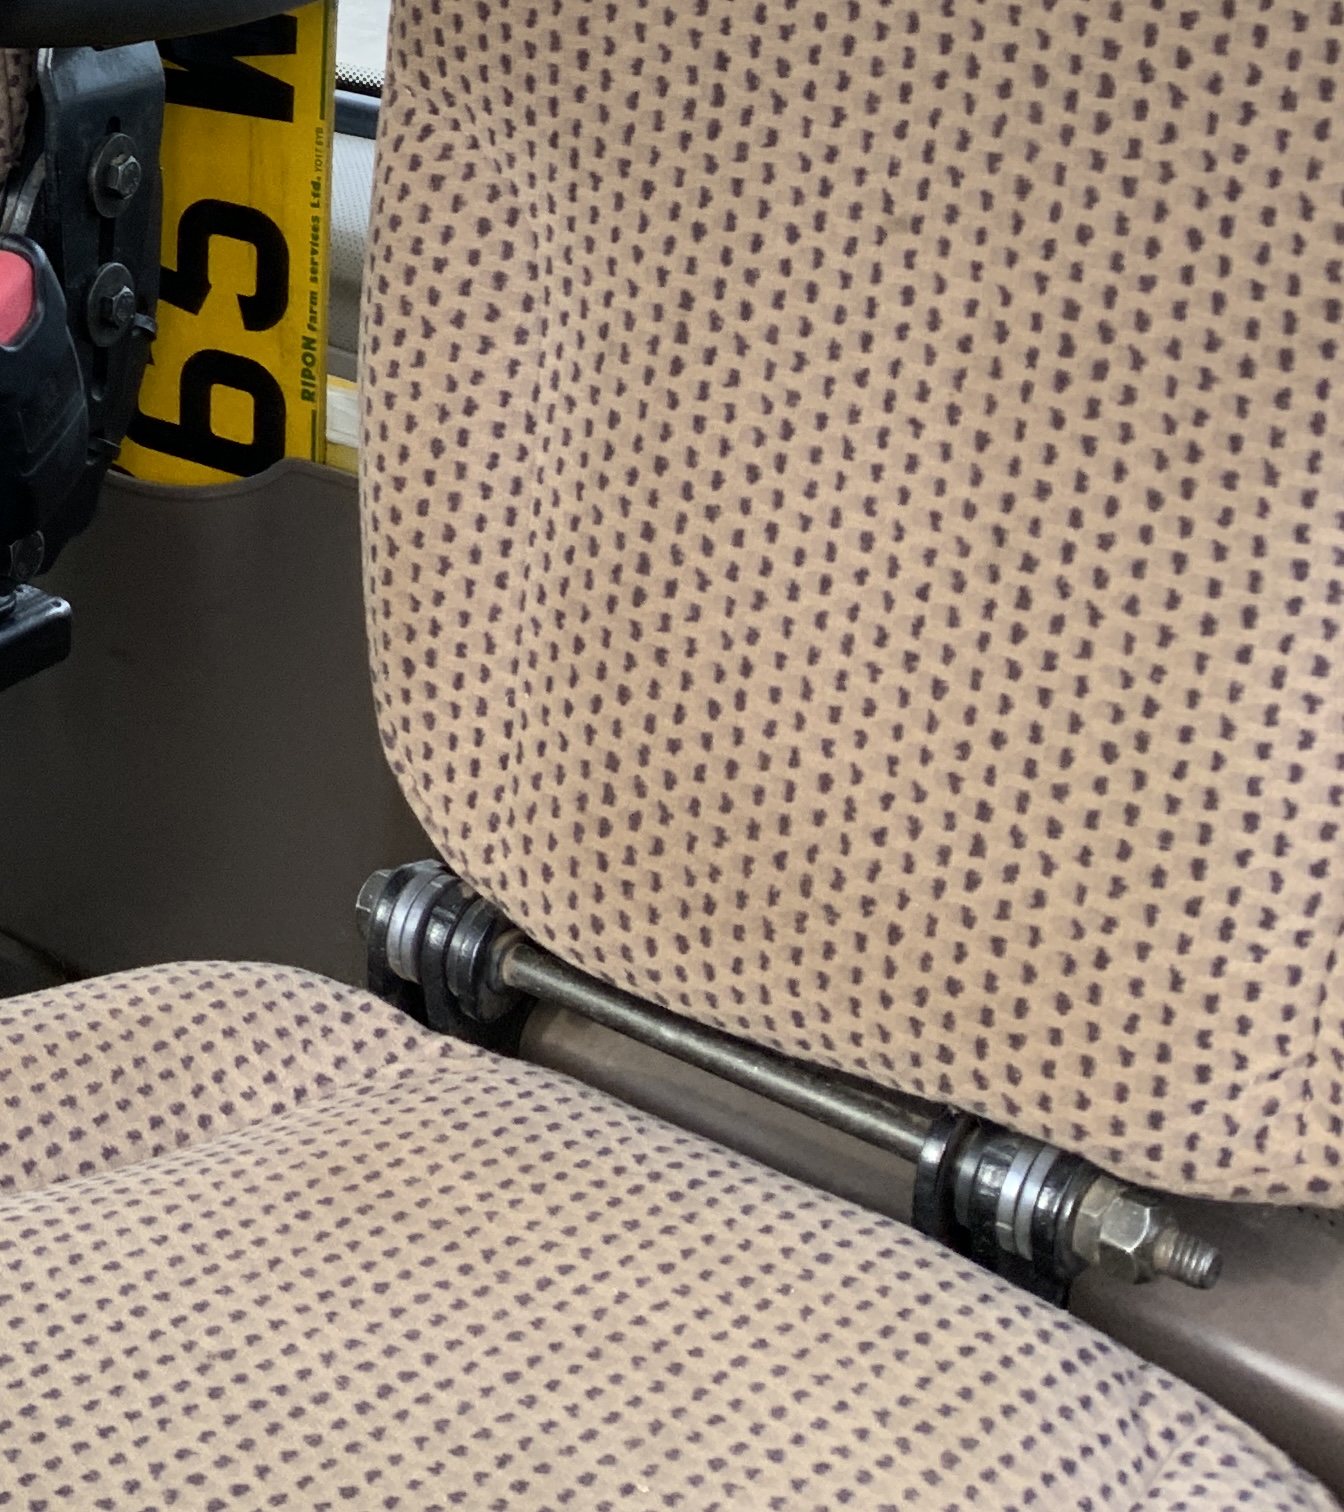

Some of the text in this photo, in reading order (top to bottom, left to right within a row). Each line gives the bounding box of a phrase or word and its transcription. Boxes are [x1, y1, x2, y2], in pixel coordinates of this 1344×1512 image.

[310, 176, 322, 209] Ltd.
[309, 215, 321, 284] services
[306, 290, 318, 332] farm
[300, 335, 317, 402] RIPON
